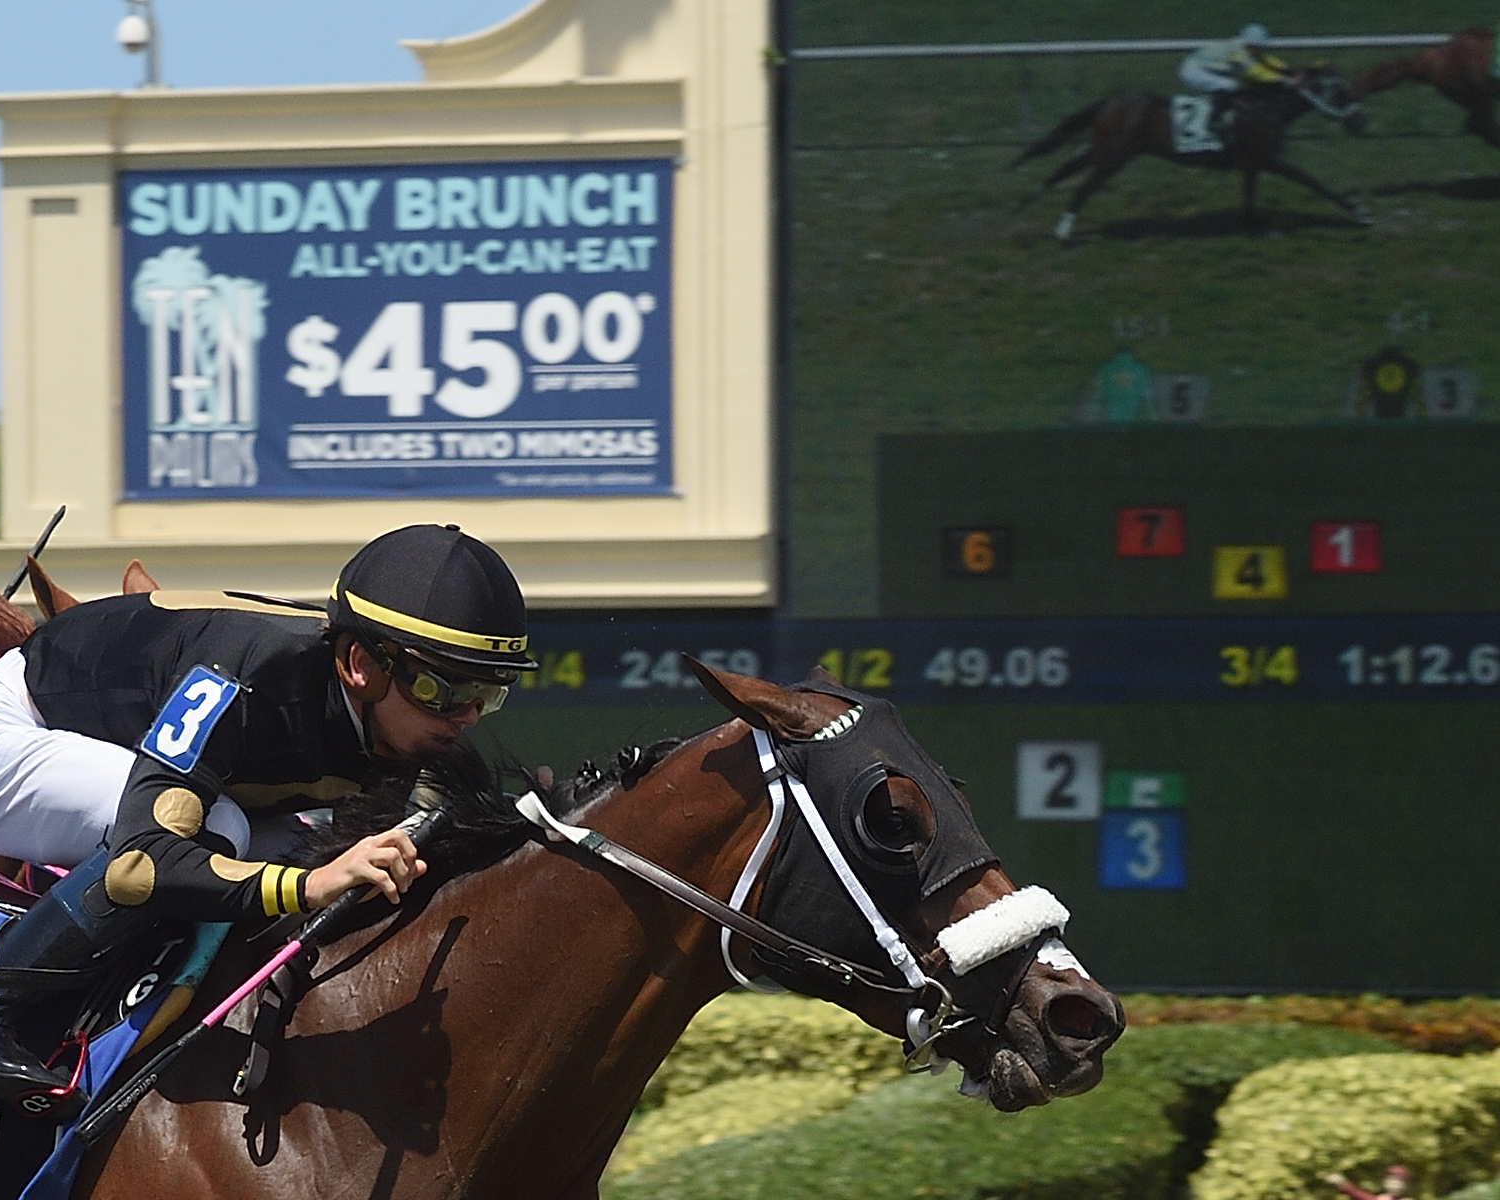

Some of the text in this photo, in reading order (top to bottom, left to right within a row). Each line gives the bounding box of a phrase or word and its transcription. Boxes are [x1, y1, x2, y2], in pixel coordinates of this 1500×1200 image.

[129, 172, 657, 236] SUNDAY BRUNCH
[290, 236, 658, 278] ALL-YOU-CAN-EAT
[288, 430, 659, 461] INCLUDES TWO MIMOSAS
[1141, 511, 1166, 548] 7
[1329, 526, 1354, 567] 1
[962, 531, 993, 572] 6
[1235, 551, 1267, 591] 4
[485, 638, 522, 651] TG
[923, 646, 1070, 688] 49.06
[1219, 645, 1298, 687] 3/4
[156, 678, 222, 758] 3
[1044, 756, 1078, 808] 2
[1126, 818, 1162, 880] 3
